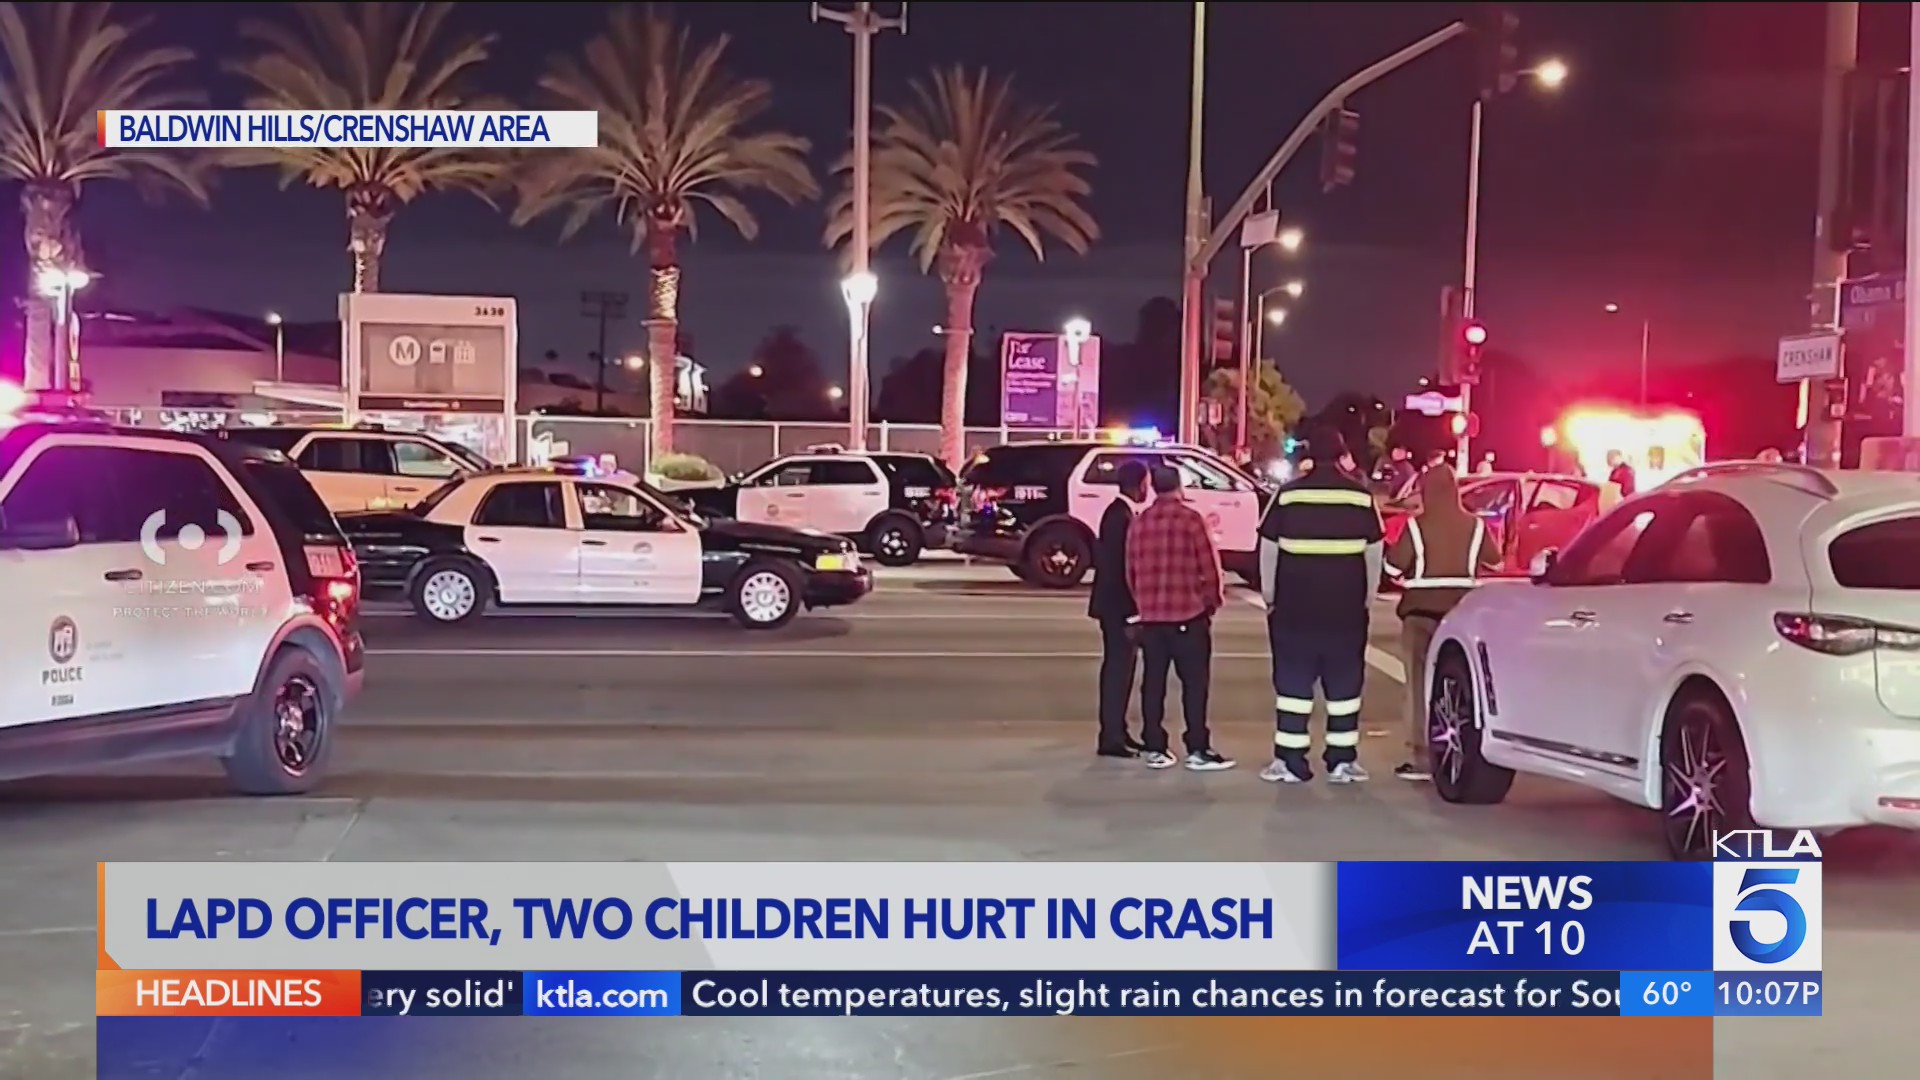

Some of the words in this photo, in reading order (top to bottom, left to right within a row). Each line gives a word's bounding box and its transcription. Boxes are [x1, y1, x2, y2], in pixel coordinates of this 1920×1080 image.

[1008, 353, 1046, 370] Lease
[1782, 348, 1833, 367] CRENSHAW
[42, 666, 83, 685] POLICE
